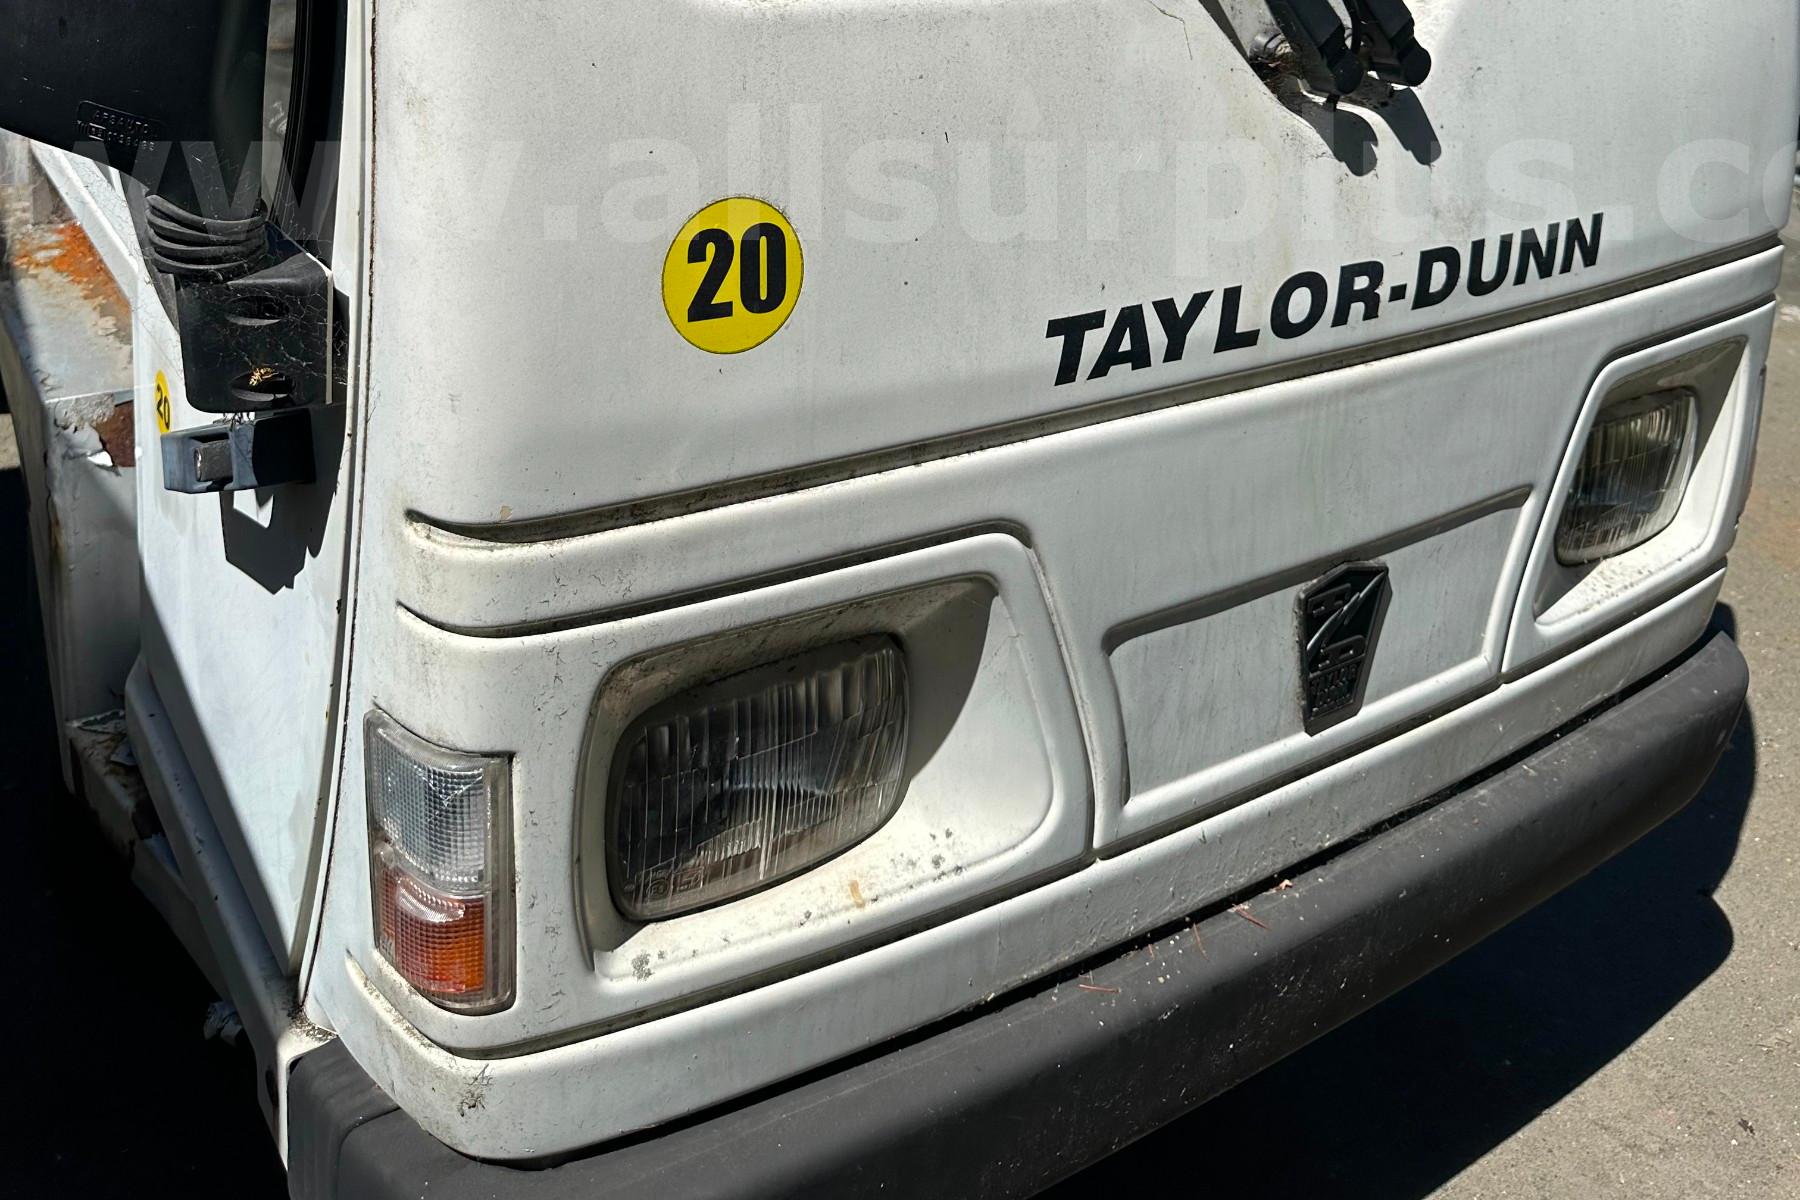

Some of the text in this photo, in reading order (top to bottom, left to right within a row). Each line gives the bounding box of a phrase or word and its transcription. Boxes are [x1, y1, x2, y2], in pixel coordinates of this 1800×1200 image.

[687, 222, 788, 324] 20
[1044, 212, 1605, 388] TAYLOR-DUNN
[156, 383, 170, 430] 20
